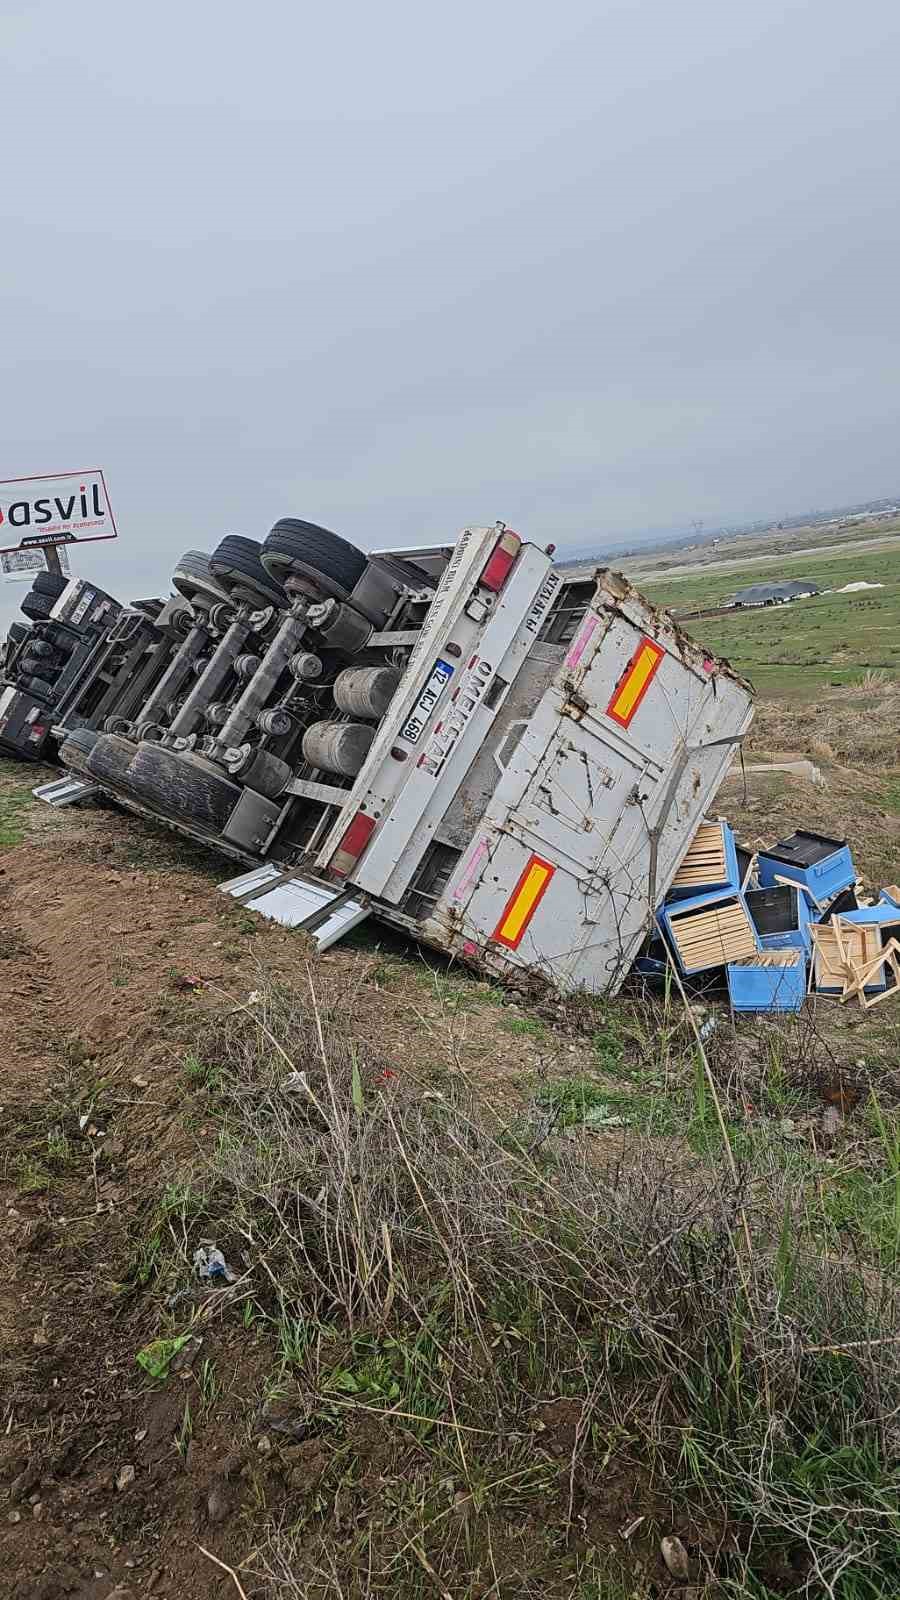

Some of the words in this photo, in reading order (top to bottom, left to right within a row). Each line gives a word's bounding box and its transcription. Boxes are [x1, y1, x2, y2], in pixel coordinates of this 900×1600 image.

[8, 484, 104, 526] asvil
[432, 670, 448, 685] 12
[419, 688, 438, 712] ACJ
[404, 716, 424, 740] 468
